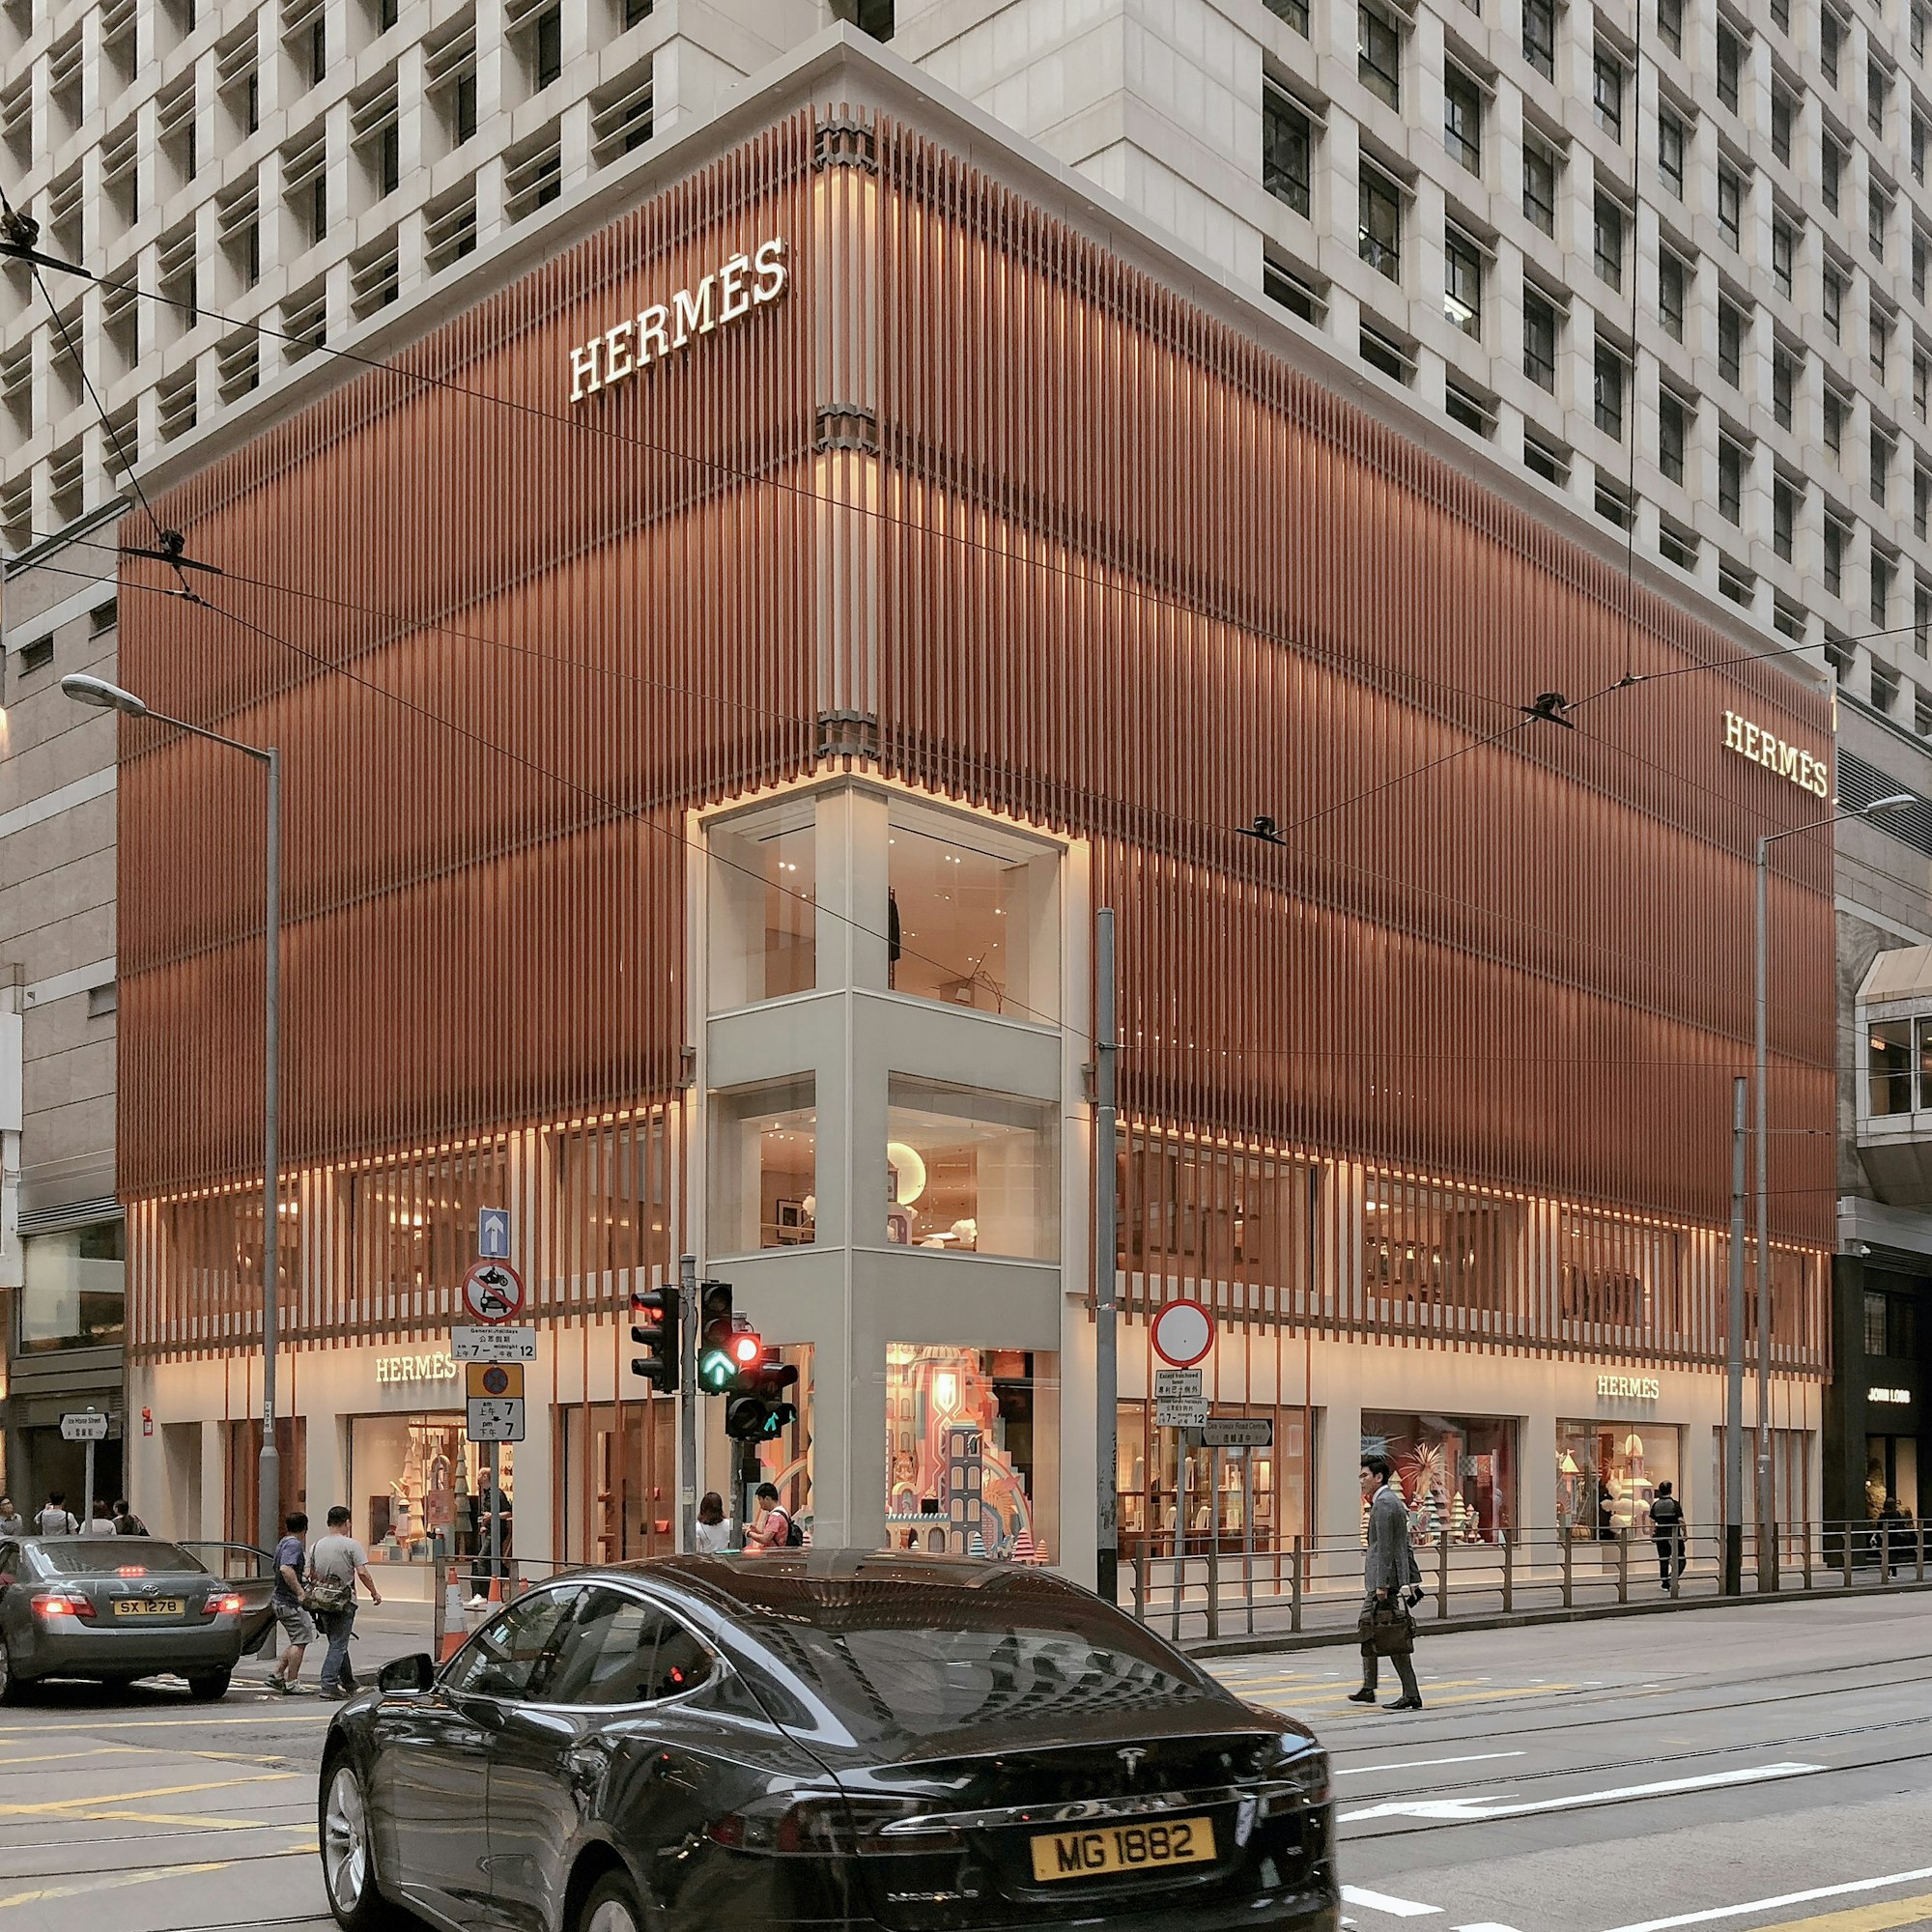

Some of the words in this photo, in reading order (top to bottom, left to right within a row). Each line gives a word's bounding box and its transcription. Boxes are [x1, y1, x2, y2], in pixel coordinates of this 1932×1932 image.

[570, 237, 788, 403] HERMÈS
[1724, 710, 1828, 799] HERMÈS
[470, 1345, 479, 1356] 7
[520, 1345, 533, 1356] 12
[1597, 1375, 1660, 1400] HERMÈS
[478, 1407, 496, 1416] 上午
[504, 1402, 514, 1415] 7
[1166, 1413, 1171, 1422] 7
[1194, 1413, 1205, 1424] 12
[504, 1422, 514, 1436] 7
[1236, 1421, 1248, 1430] Road
[479, 1429, 497, 1437] 下午
[121, 1602, 139, 1613] SX
[144, 1602, 177, 1612] 1278
[1055, 1834, 1106, 1872] MG
[1115, 1824, 1194, 1864] 1882
